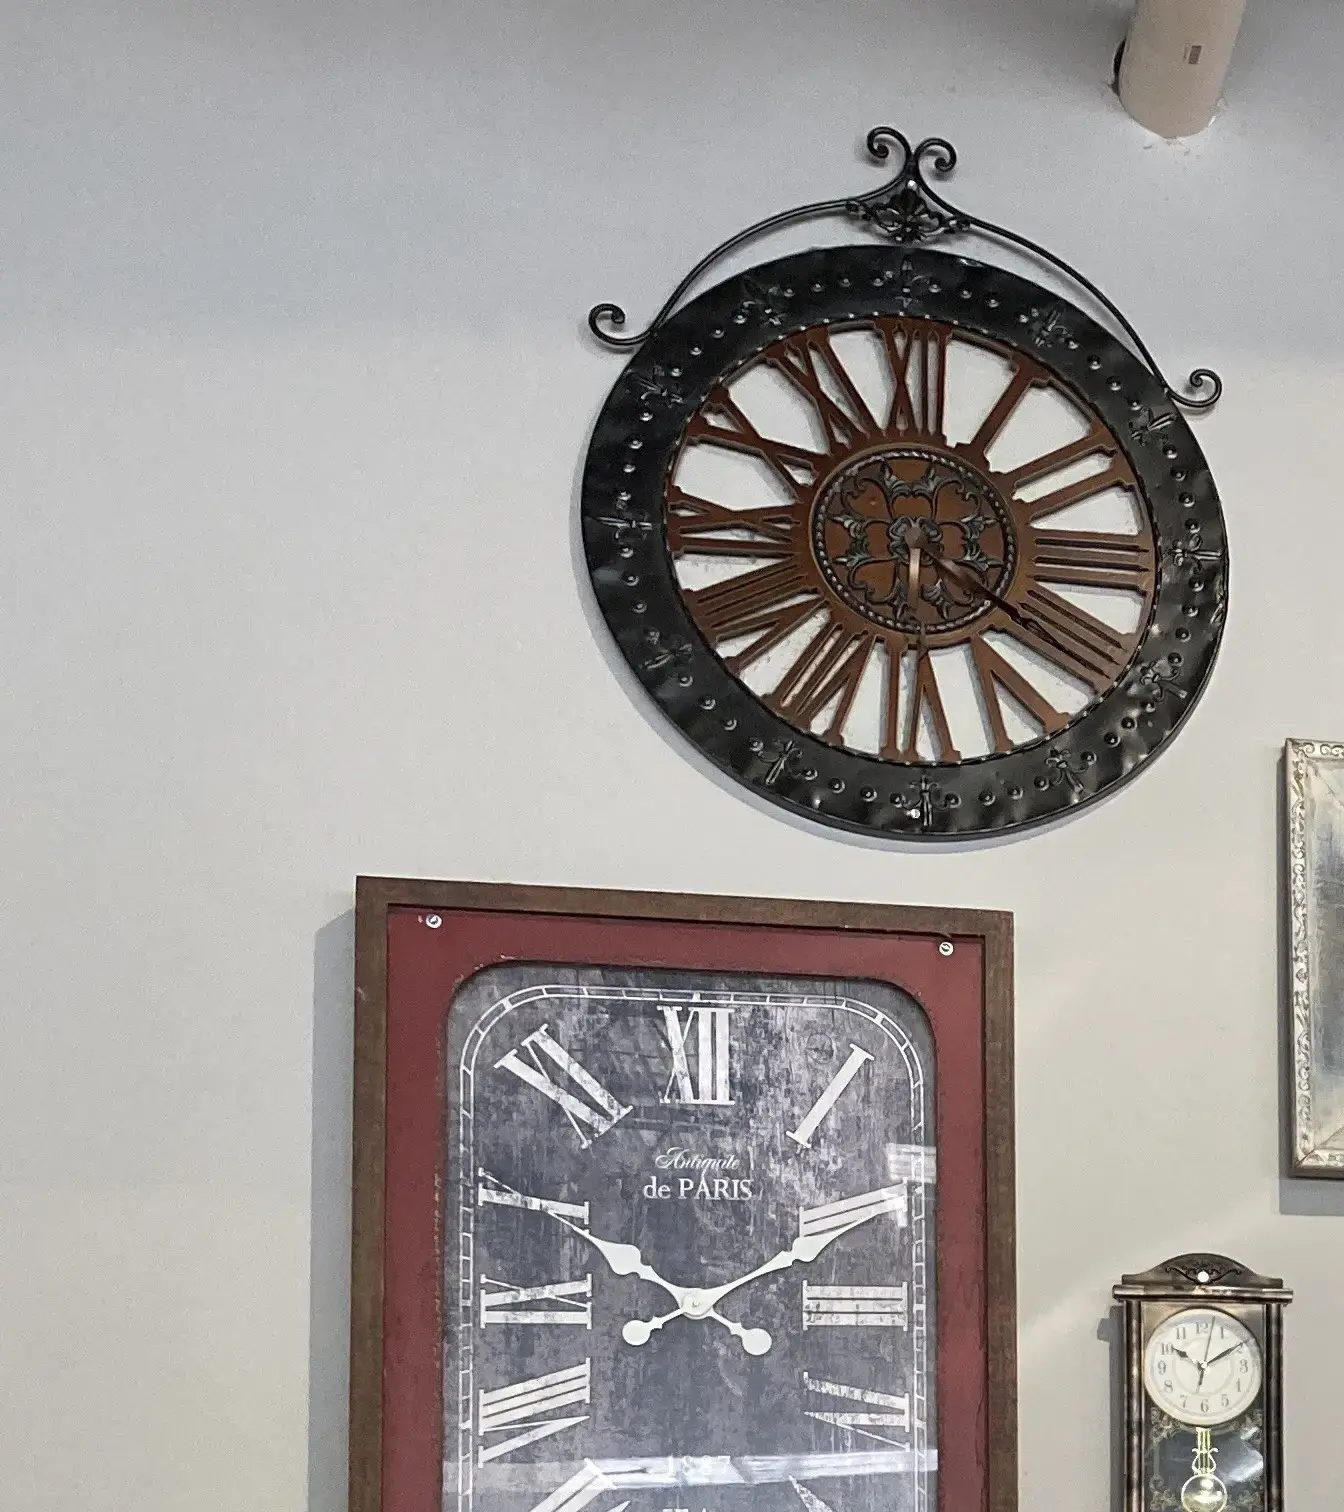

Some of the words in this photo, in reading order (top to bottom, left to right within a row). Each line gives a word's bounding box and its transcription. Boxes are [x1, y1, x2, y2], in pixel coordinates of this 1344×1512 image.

[876, 318, 953, 438] XII
[956, 352, 1055, 458] I
[1028, 527, 1155, 596] III
[972, 633, 1072, 755] V
[494, 1024, 634, 1150] XI
[657, 1005, 736, 1106] XII
[786, 1043, 875, 1149] I
[643, 1176, 671, 1199] de
[678, 1178, 753, 1200] PARIS
[479, 1273, 593, 1331] IX
[802, 1281, 909, 1332] III
[477, 1359, 592, 1468] VIII
